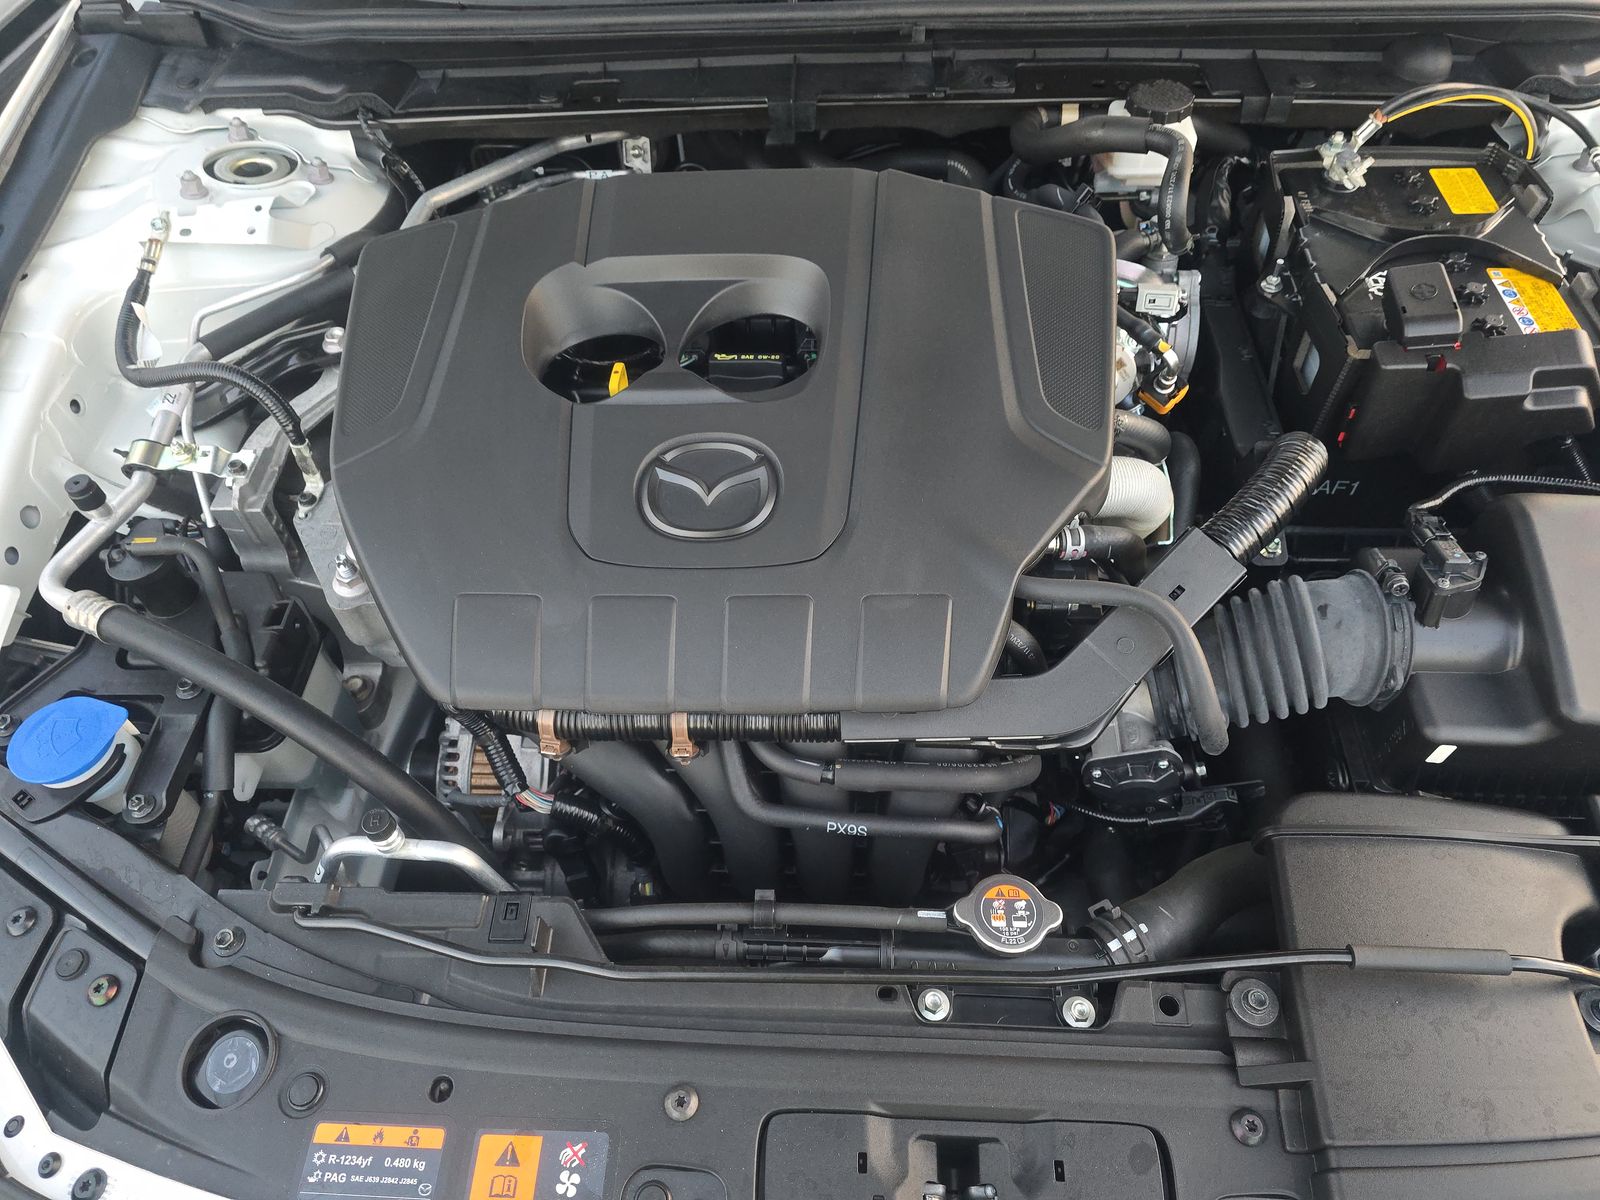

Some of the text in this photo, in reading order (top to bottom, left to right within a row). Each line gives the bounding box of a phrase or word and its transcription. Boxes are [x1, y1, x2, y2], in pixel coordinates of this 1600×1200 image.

[328, 1154, 426, 1171] R-1234yf 0.480 kg
[323, 1172, 347, 1183] PAG
